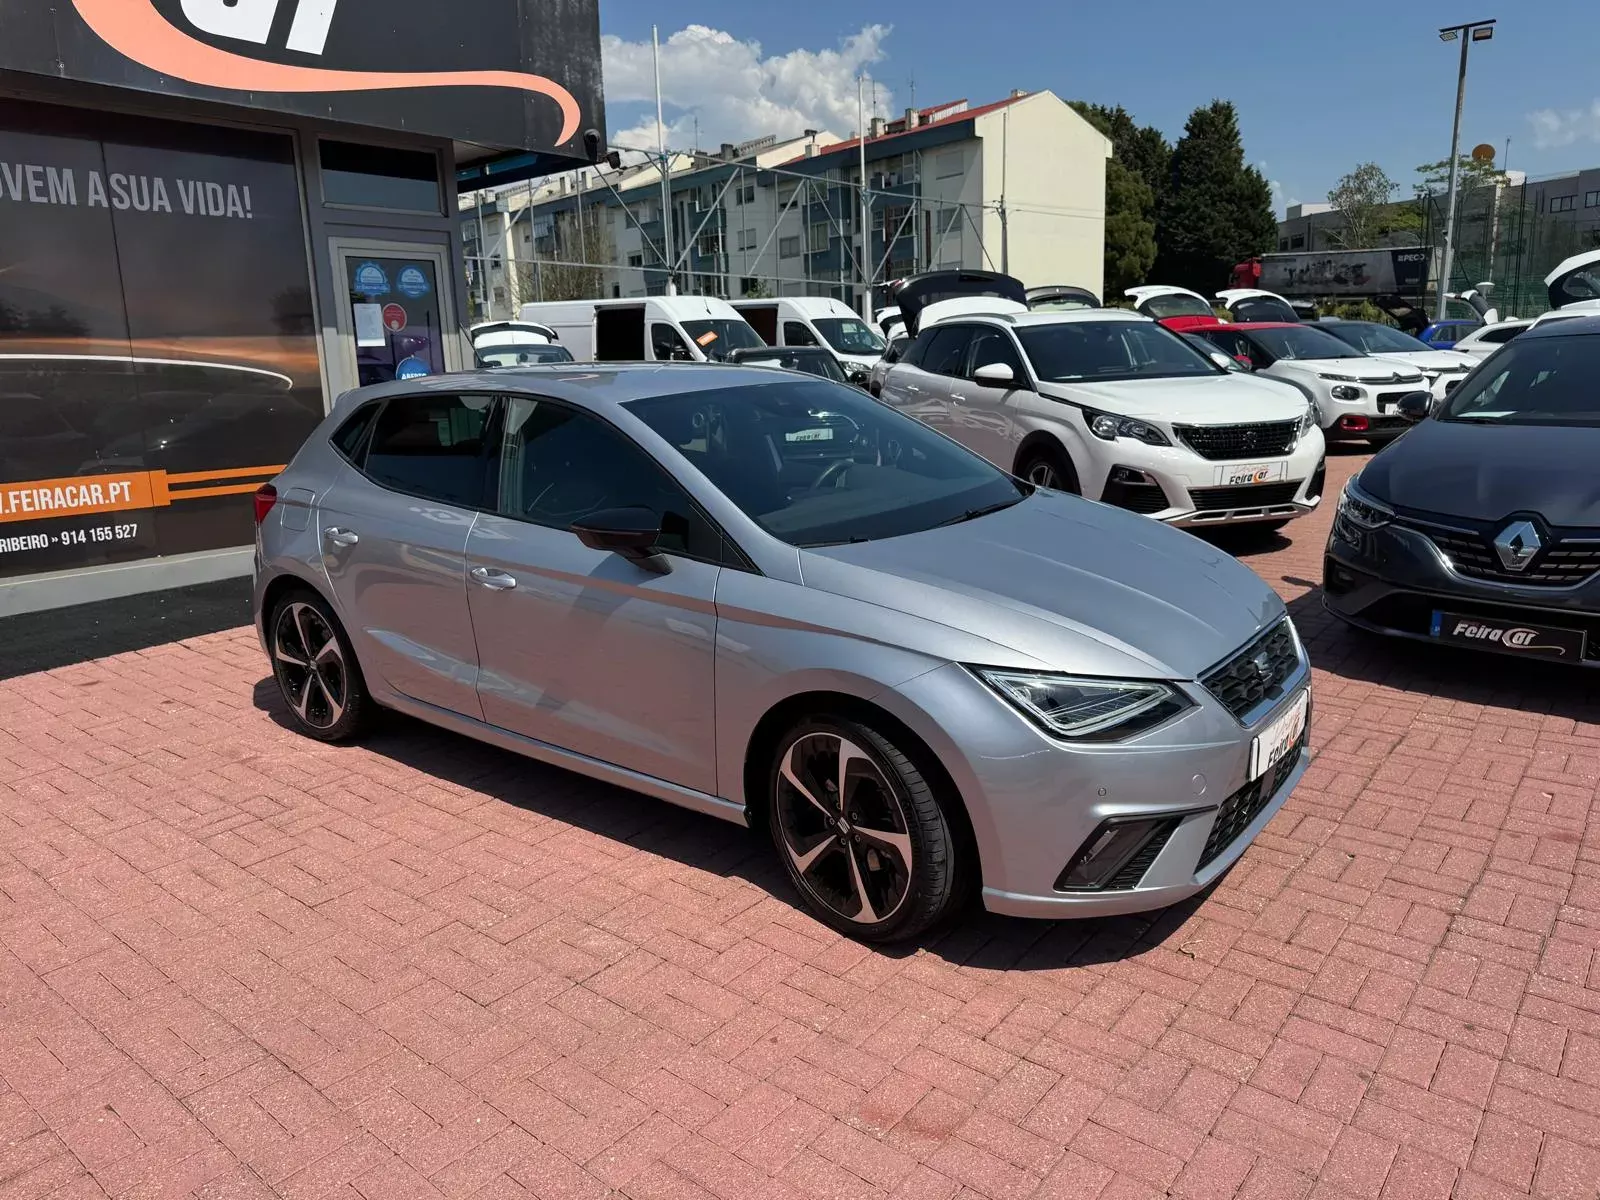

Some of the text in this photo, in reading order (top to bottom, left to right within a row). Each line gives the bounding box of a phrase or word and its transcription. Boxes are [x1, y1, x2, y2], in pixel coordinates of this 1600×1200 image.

[0, 161, 77, 206] VEM
[175, 178, 253, 219] VIDA!
[0, 481, 131, 514] .FEIRACAR.PT
[61, 529, 87, 546] 914
[89, 526, 113, 542] 155
[115, 523, 138, 539] 527
[1452, 622, 1542, 650] FeiraCar
